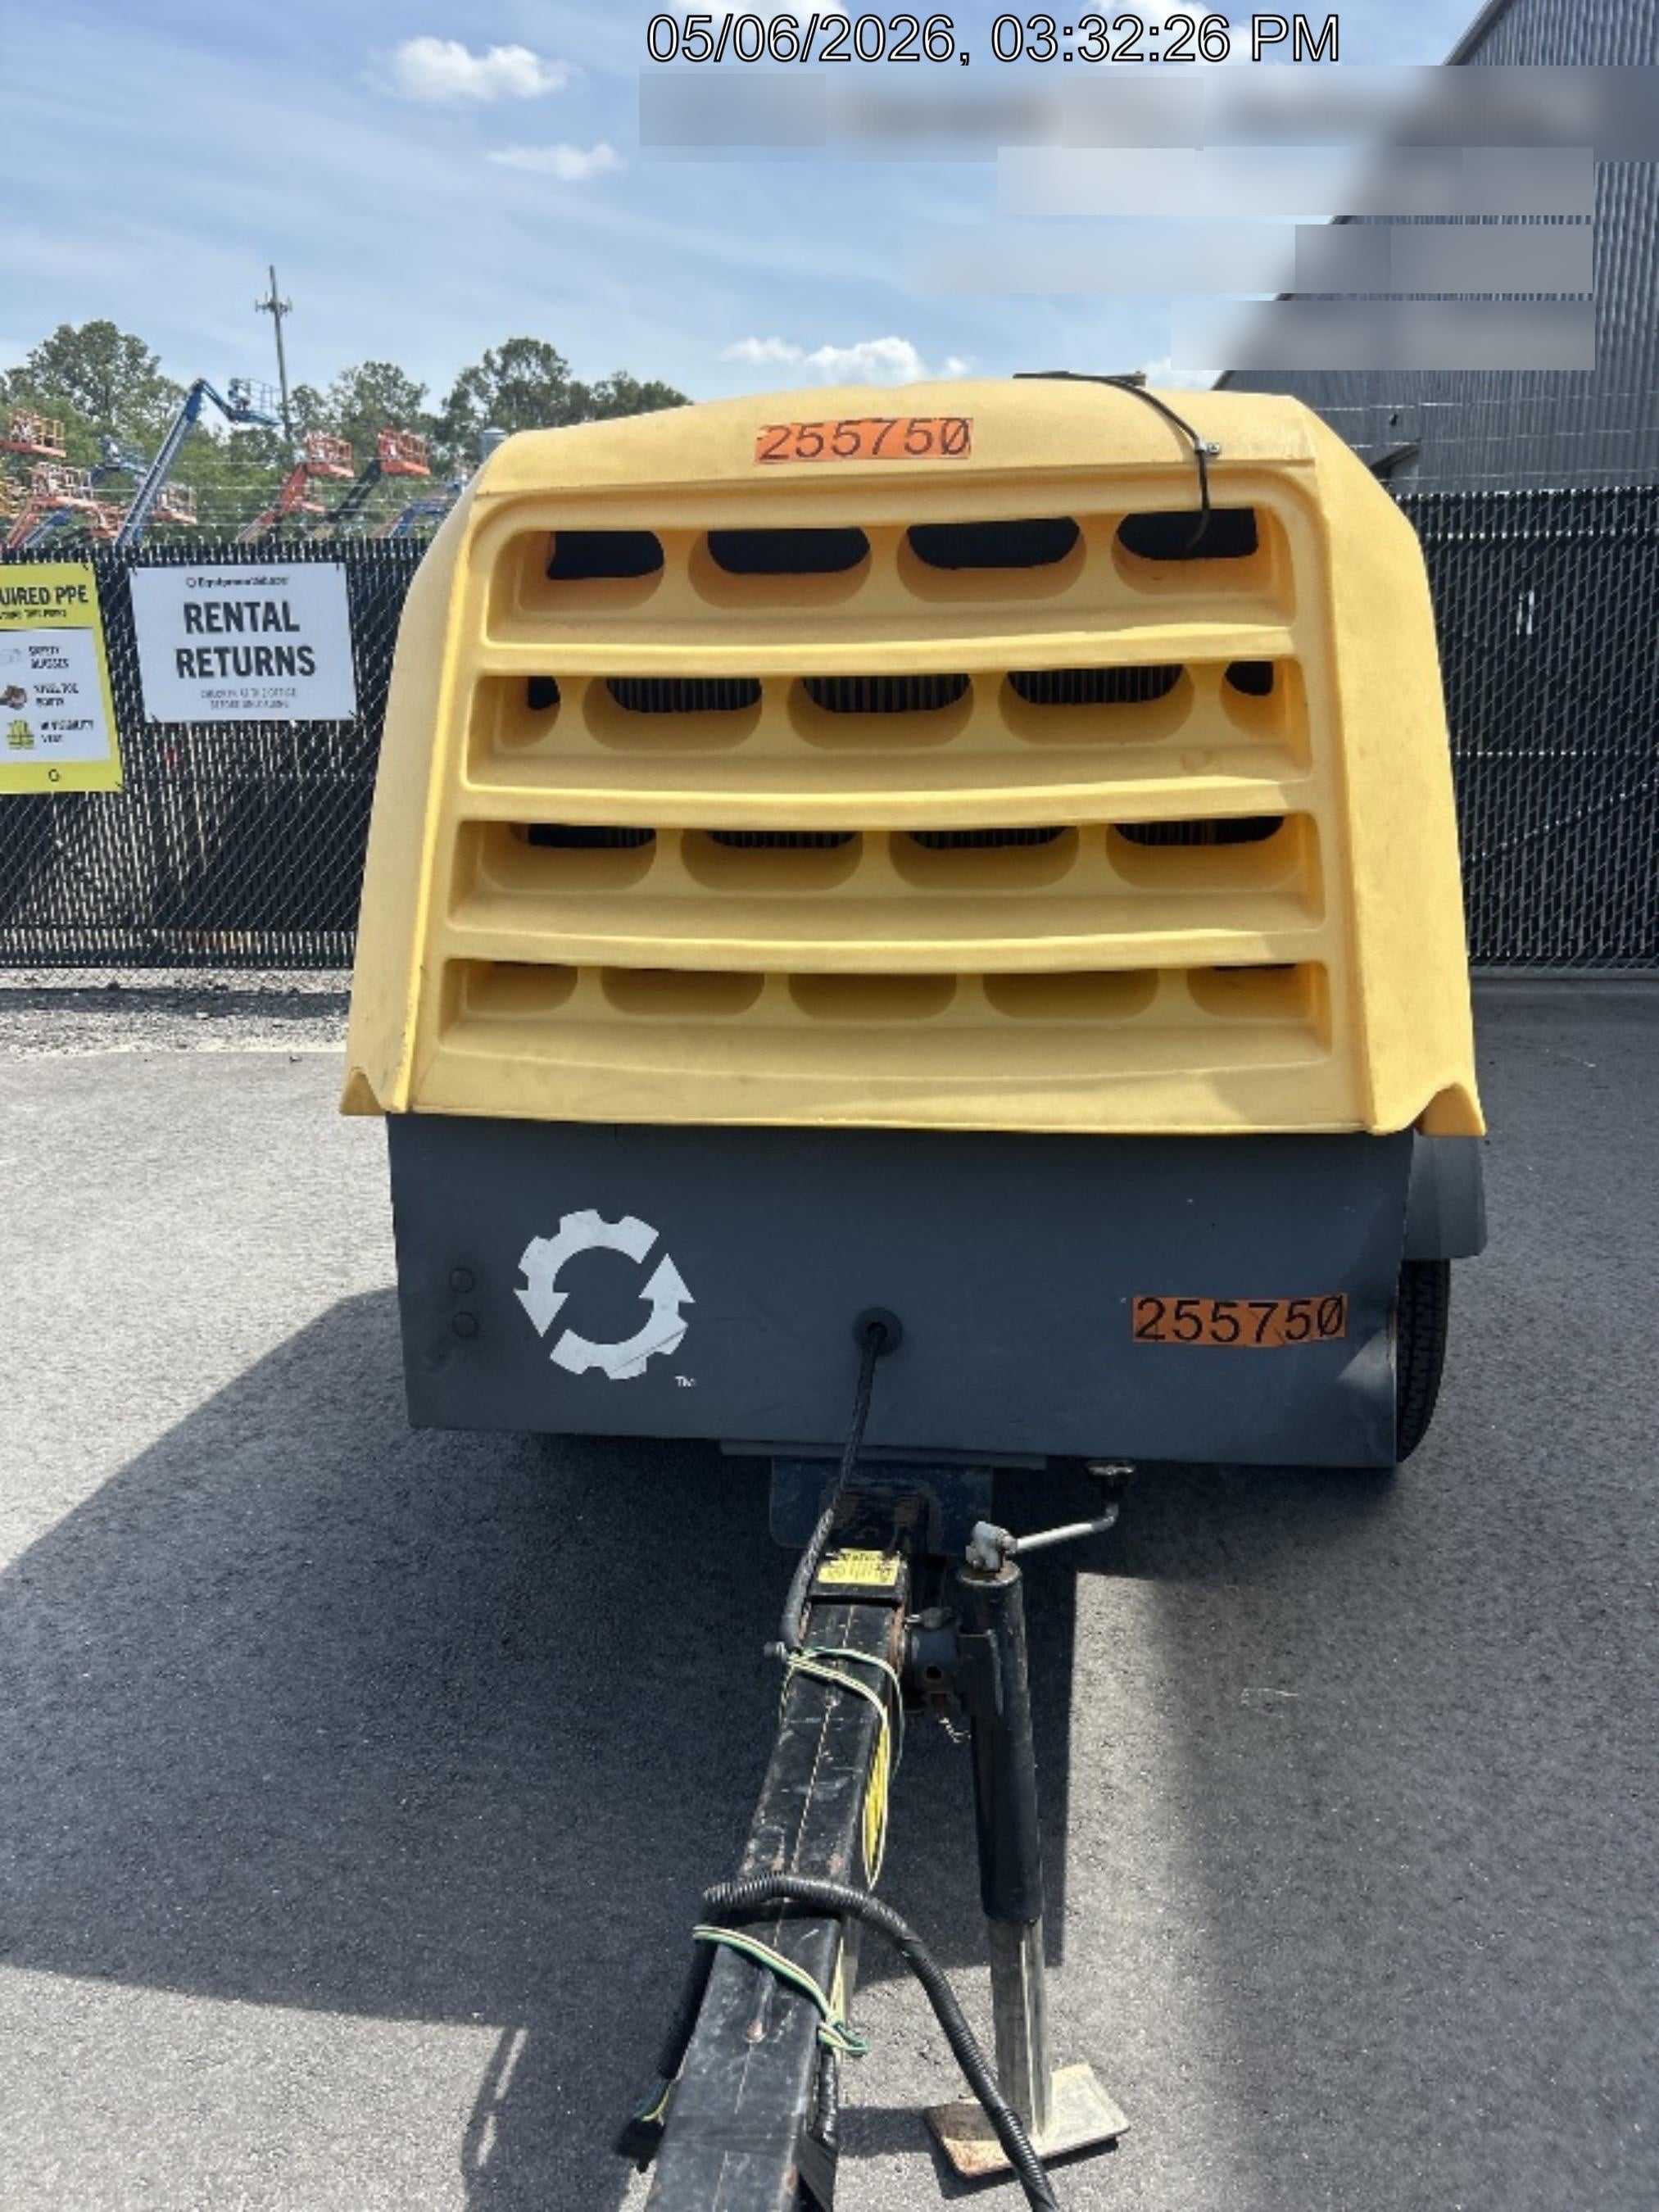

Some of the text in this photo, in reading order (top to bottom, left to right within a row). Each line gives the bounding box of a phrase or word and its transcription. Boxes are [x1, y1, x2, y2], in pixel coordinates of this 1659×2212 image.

[757, 417, 970, 461] 255750
[55, 584, 88, 605] PPE
[184, 601, 301, 634] RENTAL
[175, 645, 315, 679] RETURNS
[1135, 1294, 1344, 1343] 255750
